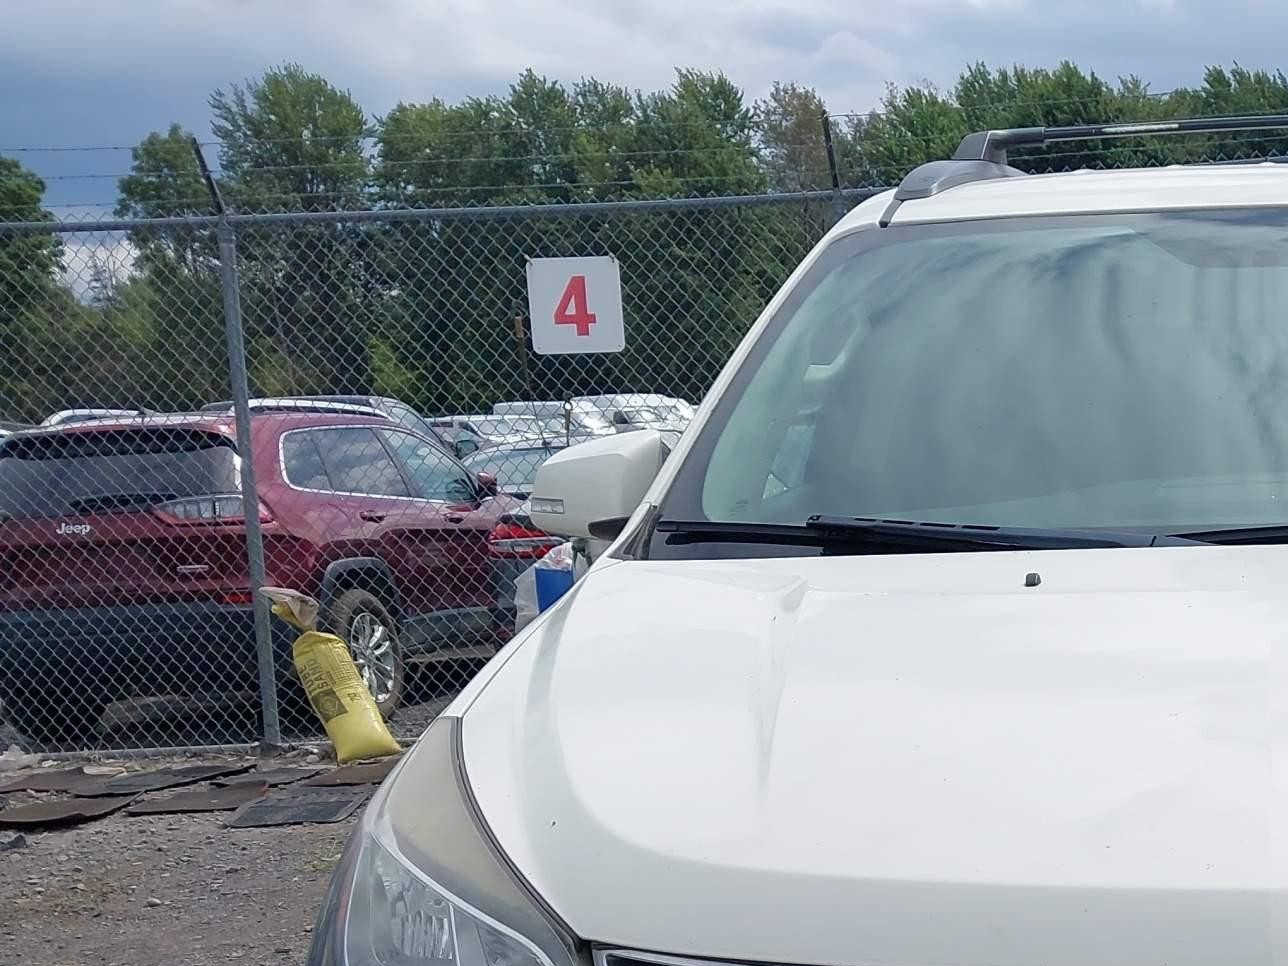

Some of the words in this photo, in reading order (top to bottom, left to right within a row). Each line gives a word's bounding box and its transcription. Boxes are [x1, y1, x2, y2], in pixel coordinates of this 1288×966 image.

[553, 275, 598, 337] 4
[55, 522, 91, 536] Jeep
[299, 664, 316, 697] TUBE
[305, 658, 328, 690] SAND
